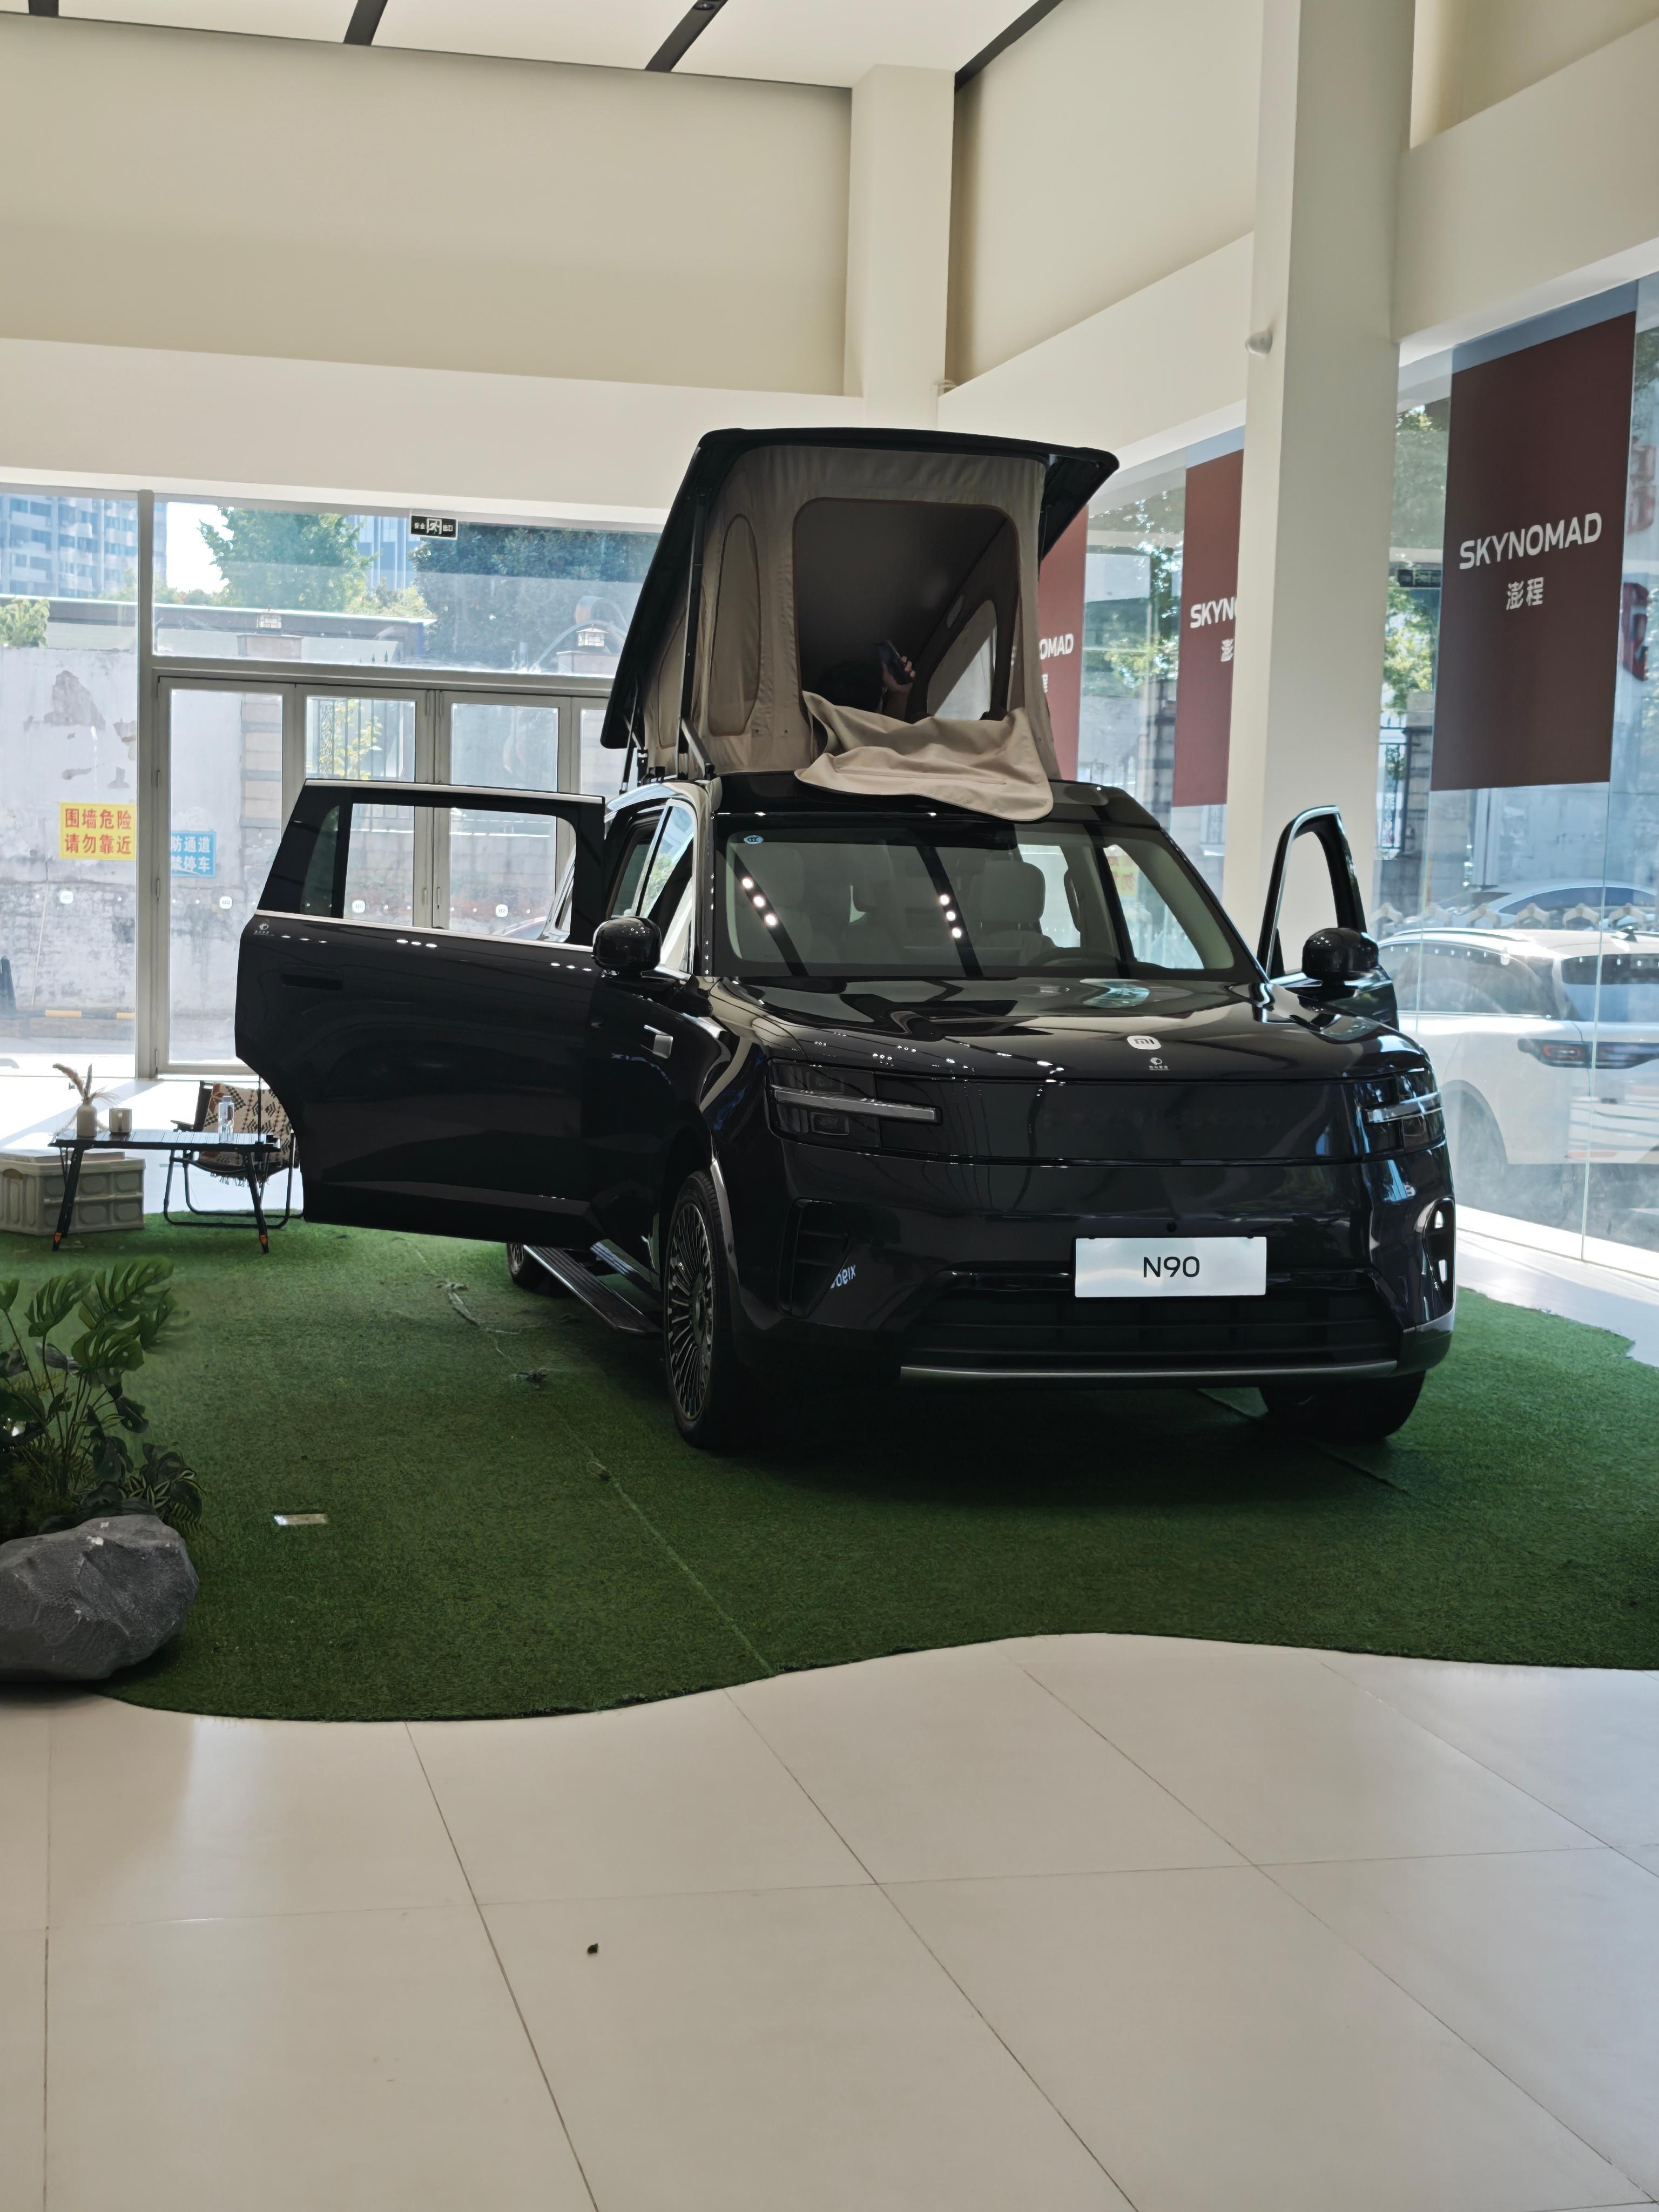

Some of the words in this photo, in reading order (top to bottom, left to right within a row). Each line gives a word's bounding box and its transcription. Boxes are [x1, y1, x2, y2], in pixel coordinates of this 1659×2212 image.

[1459, 512, 1602, 569] SKYNOMAD
[1190, 596, 1236, 629] SKYN
[1039, 633, 1074, 660] OMAD
[65, 808, 132, 830] 围墙危险
[64, 833, 131, 854] 请勿靠近
[171, 835, 210, 853] 防通道
[171, 855, 210, 873] 禁停车
[1143, 1256, 1200, 1278] N90
